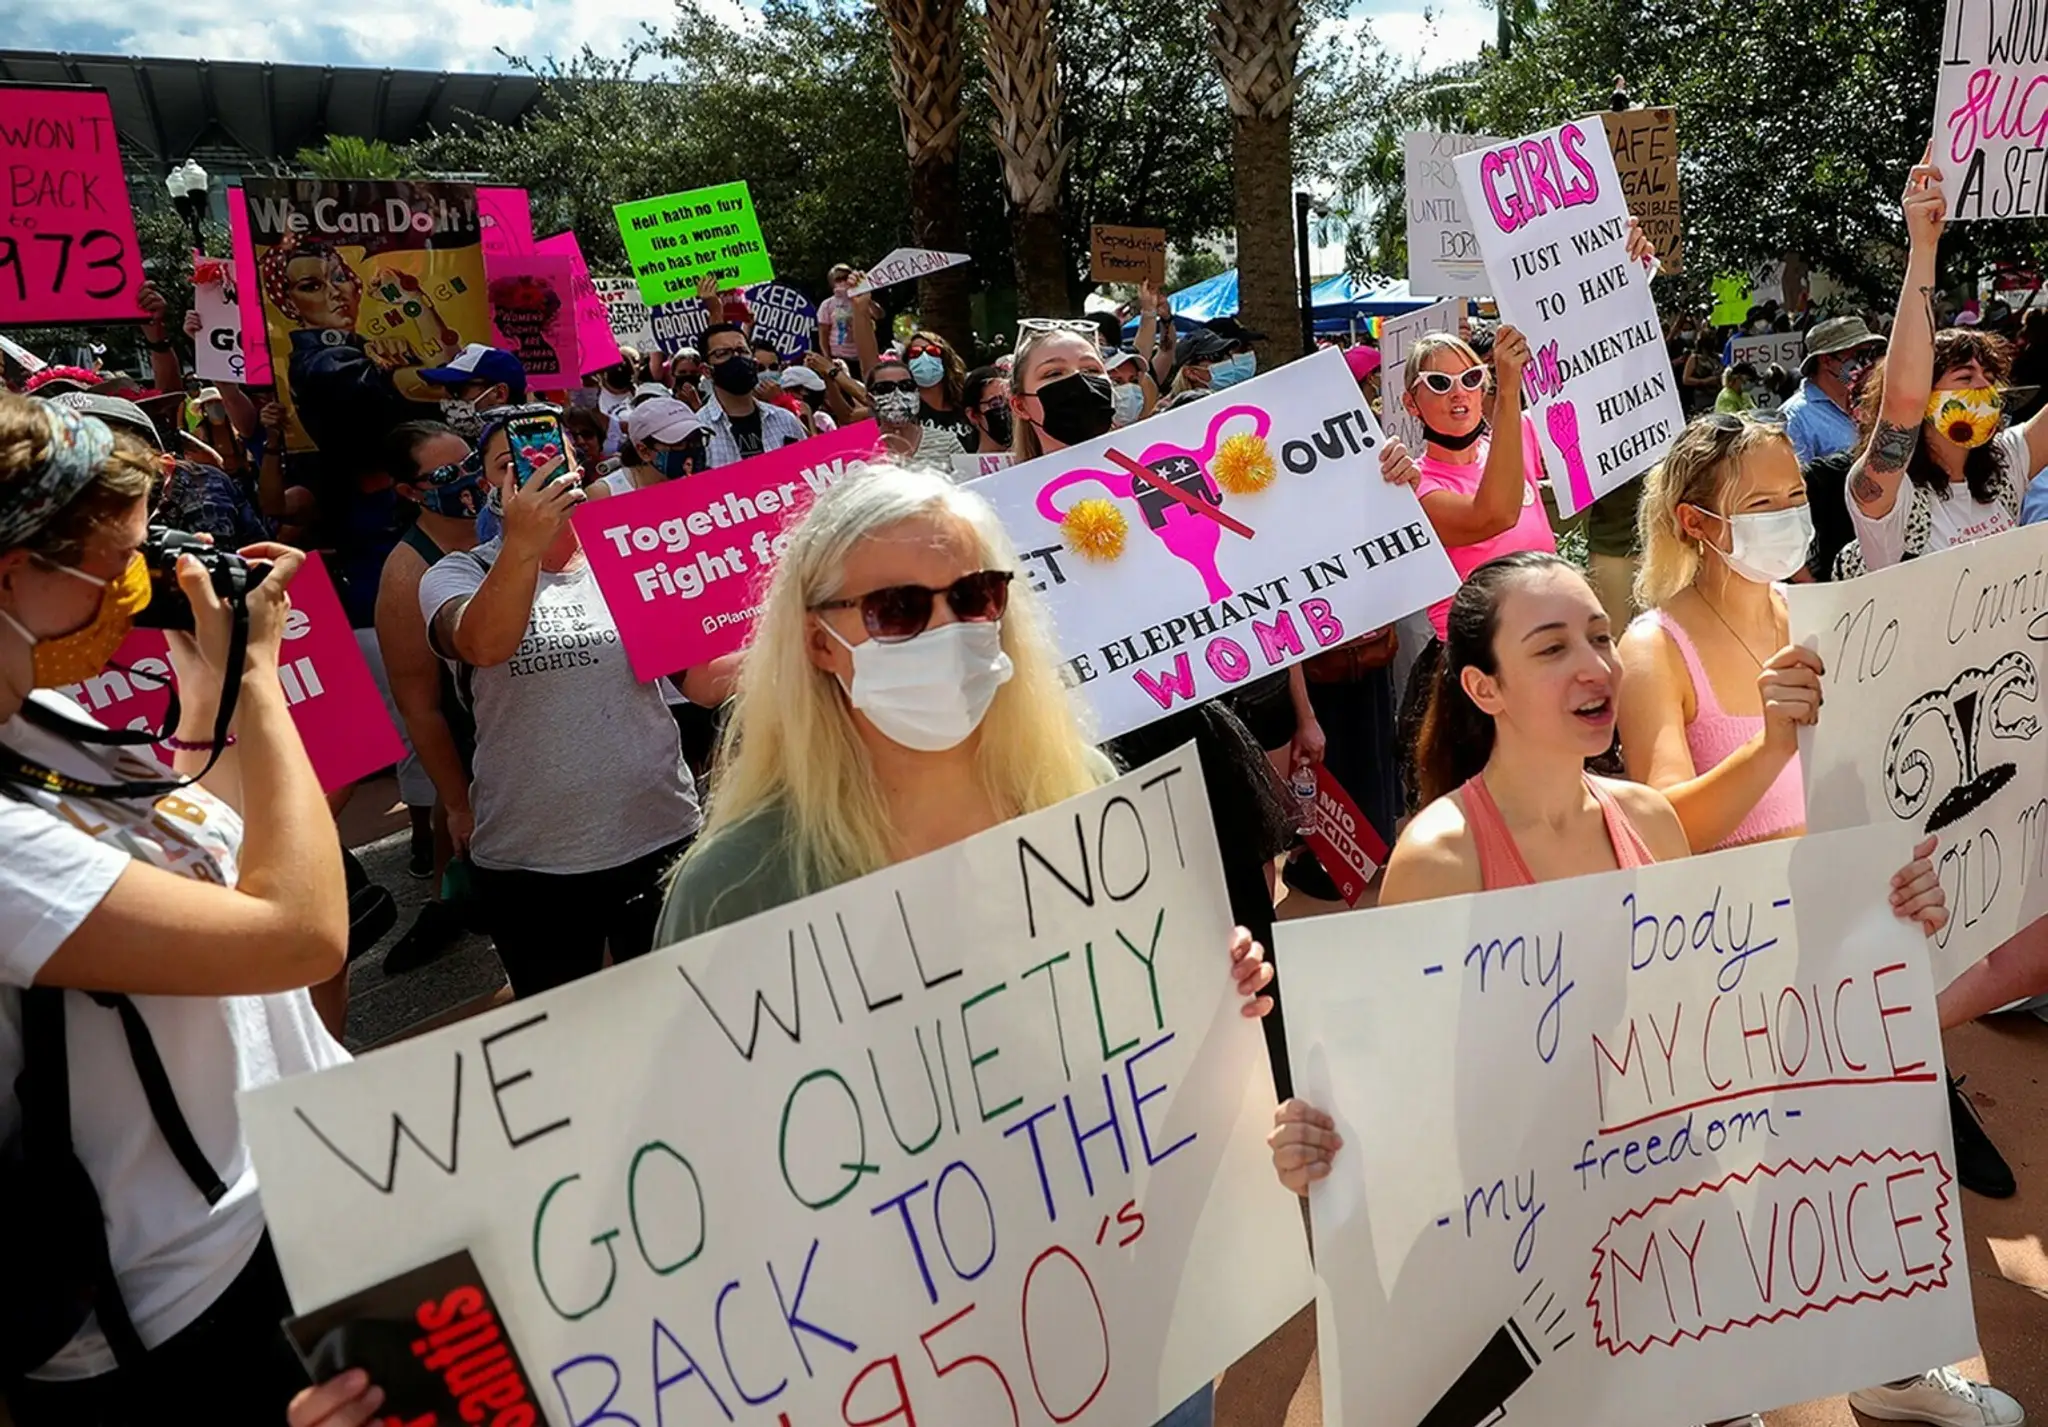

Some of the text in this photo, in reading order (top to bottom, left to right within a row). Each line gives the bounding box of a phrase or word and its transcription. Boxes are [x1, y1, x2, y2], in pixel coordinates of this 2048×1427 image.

[1608, 126, 1669, 165] AFE,
[9, 164, 107, 213] BACK
[1420, 160, 1458, 190] PRO
[1480, 122, 1600, 234] GIRLS
[1955, 148, 1986, 218] A
[9, 212, 37, 229] to
[251, 198, 309, 233] We
[314, 198, 380, 233] Can
[385, 198, 434, 233] Do
[632, 198, 743, 231] Hell hath no fury
[1410, 198, 1462, 224] UNTIL
[1627, 200, 1679, 216] SSIBLE
[638, 240, 760, 276] who has her rights
[651, 223, 740, 251] like a woman
[1511, 215, 1624, 283] JUST WANT
[867, 250, 950, 288] NEVER AGAIN
[1536, 263, 1630, 322] TO HAVE
[756, 285, 807, 312] KEEP
[654, 310, 711, 341] ABORTIO
[751, 325, 803, 356] EGAL
[1596, 371, 1667, 425] HUMAN
[1281, 409, 1375, 475] OUT!
[1596, 418, 1672, 476] RIGHTS!
[603, 482, 797, 558] Together
[634, 531, 792, 602] Fight fo
[531, 604, 586, 619] PKIN
[1098, 576, 1291, 673] ELEPHANT
[1300, 555, 1349, 593] IN
[1353, 521, 1432, 571] THE
[515, 629, 616, 657] EPRODUC
[529, 620, 565, 636] ICE
[508, 650, 599, 678] RIGHTS.
[1133, 597, 1345, 710] WOMB
[1935, 827, 2002, 949] OLD
[295, 766, 1185, 1193] WE WILL NOT
[1592, 963, 1928, 1122] MY CHOICE
[532, 907, 1165, 1320] GO QUIETLY
[552, 1032, 1198, 1427] BACK TO THE
[1609, 1167, 1937, 1342] MY VOICE
